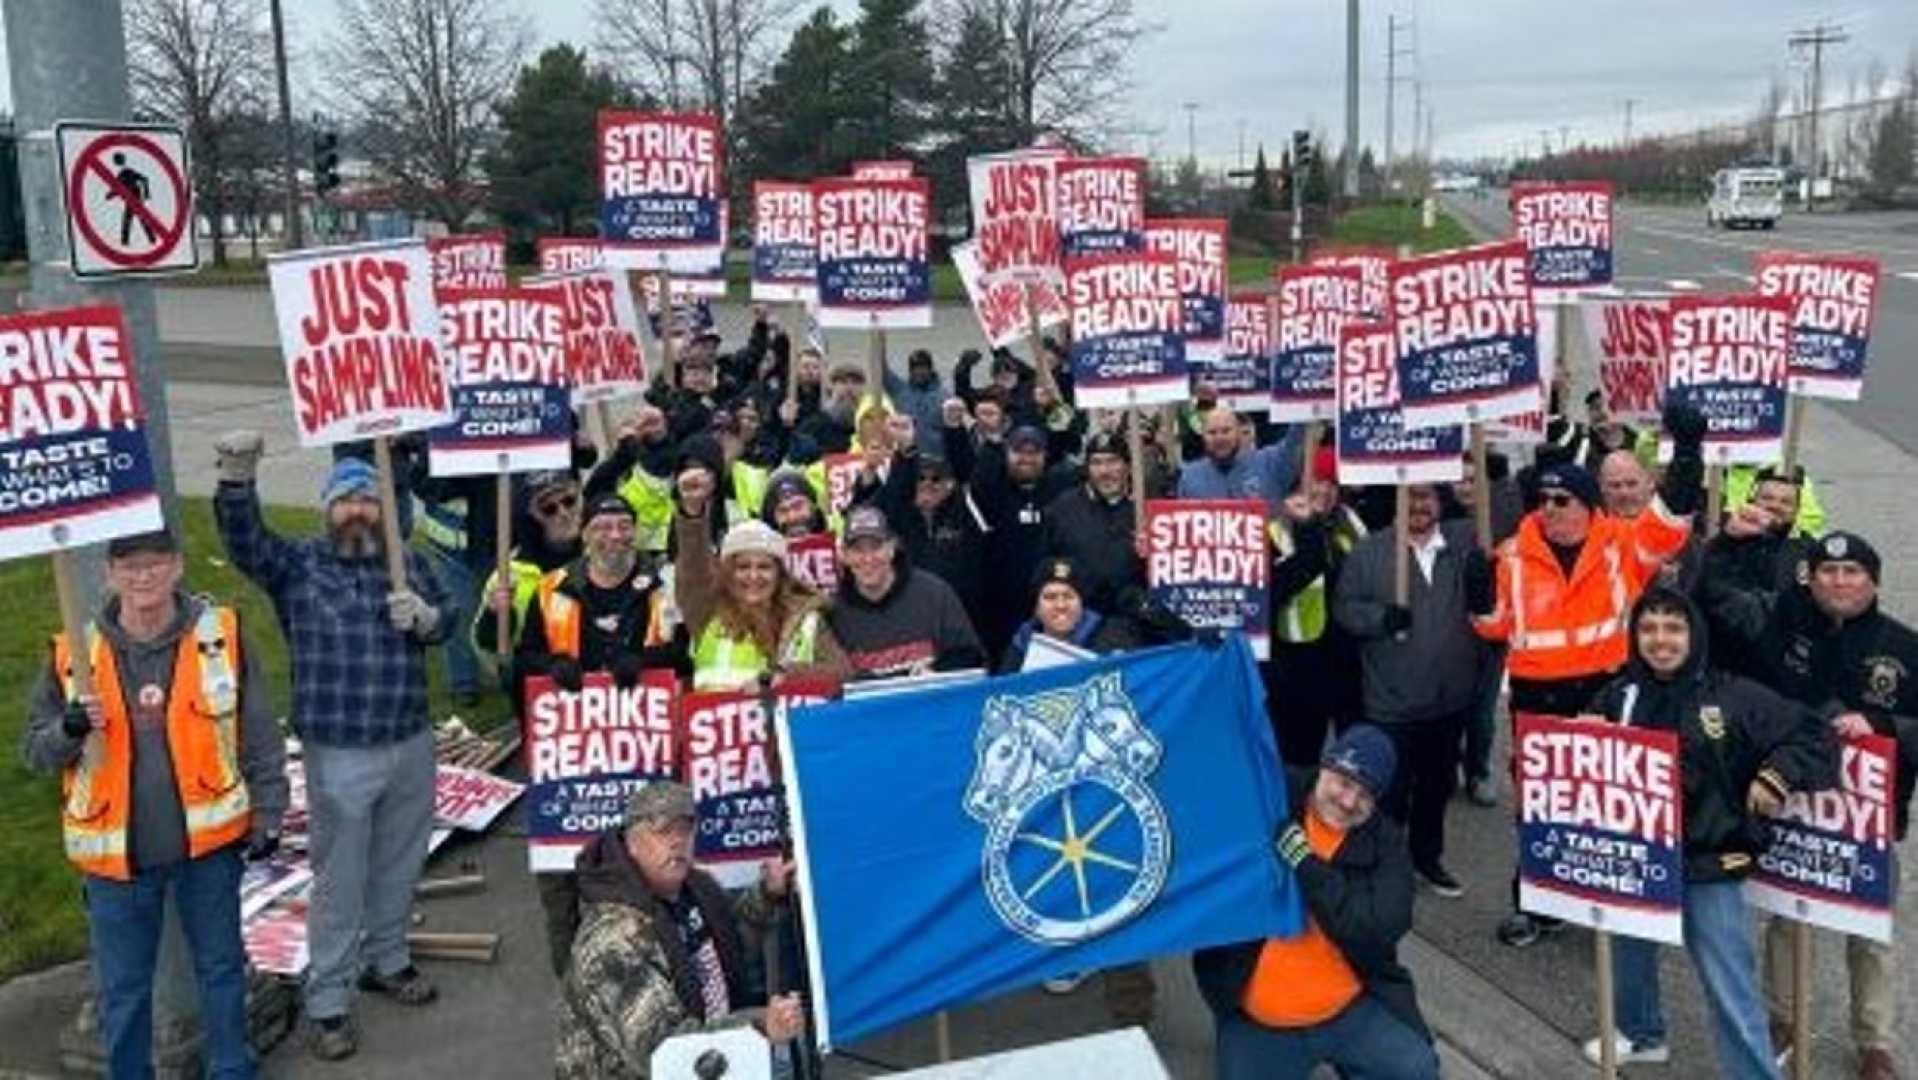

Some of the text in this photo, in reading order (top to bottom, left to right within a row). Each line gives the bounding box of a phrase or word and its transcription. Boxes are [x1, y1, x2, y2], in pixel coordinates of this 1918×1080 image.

[604, 123, 714, 163] STRIKE
[604, 160, 715, 200] READY!
[985, 165, 1050, 218] JUST
[1058, 168, 1137, 200] STRIKE
[757, 191, 815, 218] STRI
[819, 189, 926, 227] STRIKE
[1518, 191, 1609, 225] STRIKE
[820, 225, 927, 263] READY!
[1144, 229, 1222, 263] TRIKE
[1070, 260, 1176, 308] STRIKE
[1179, 263, 1222, 297] DY!
[1281, 276, 1360, 315] STRIKE
[1394, 256, 1526, 323] STRIKE
[1760, 264, 1874, 309] STRIKE
[302, 257, 411, 346] JUST
[441, 299, 565, 345] STRIKE
[563, 278, 618, 330] UST
[1073, 298, 1181, 343] READY!
[1792, 297, 1868, 338] ADY!
[1398, 297, 1531, 358] READY!
[1672, 306, 1786, 348] STRIKE
[0, 325, 127, 384] RIKE
[1439, 341, 1511, 365] TASTE
[1669, 345, 1786, 389] READY!
[294, 336, 445, 435] SAMPLING
[1430, 371, 1511, 394] COME!
[0, 379, 136, 441] ADY!
[2, 437, 109, 469] TASTE
[1151, 511, 1264, 550] STRIKE
[785, 549, 837, 590] IKE
[1151, 548, 1265, 590] READY!
[533, 686, 672, 736] STRIKE
[690, 699, 768, 756] STR
[533, 729, 673, 785] READY!
[691, 744, 773, 804] REA
[1522, 731, 1675, 801] STRIKE
[562, 814, 623, 831] COM
[1522, 778, 1675, 848] READY!
[1783, 786, 1887, 851] ADY!
[724, 829, 780, 847] COM
[1564, 831, 1649, 859] TASTE
[1773, 825, 1859, 860] TASTE
[1553, 862, 1645, 896] COME!
